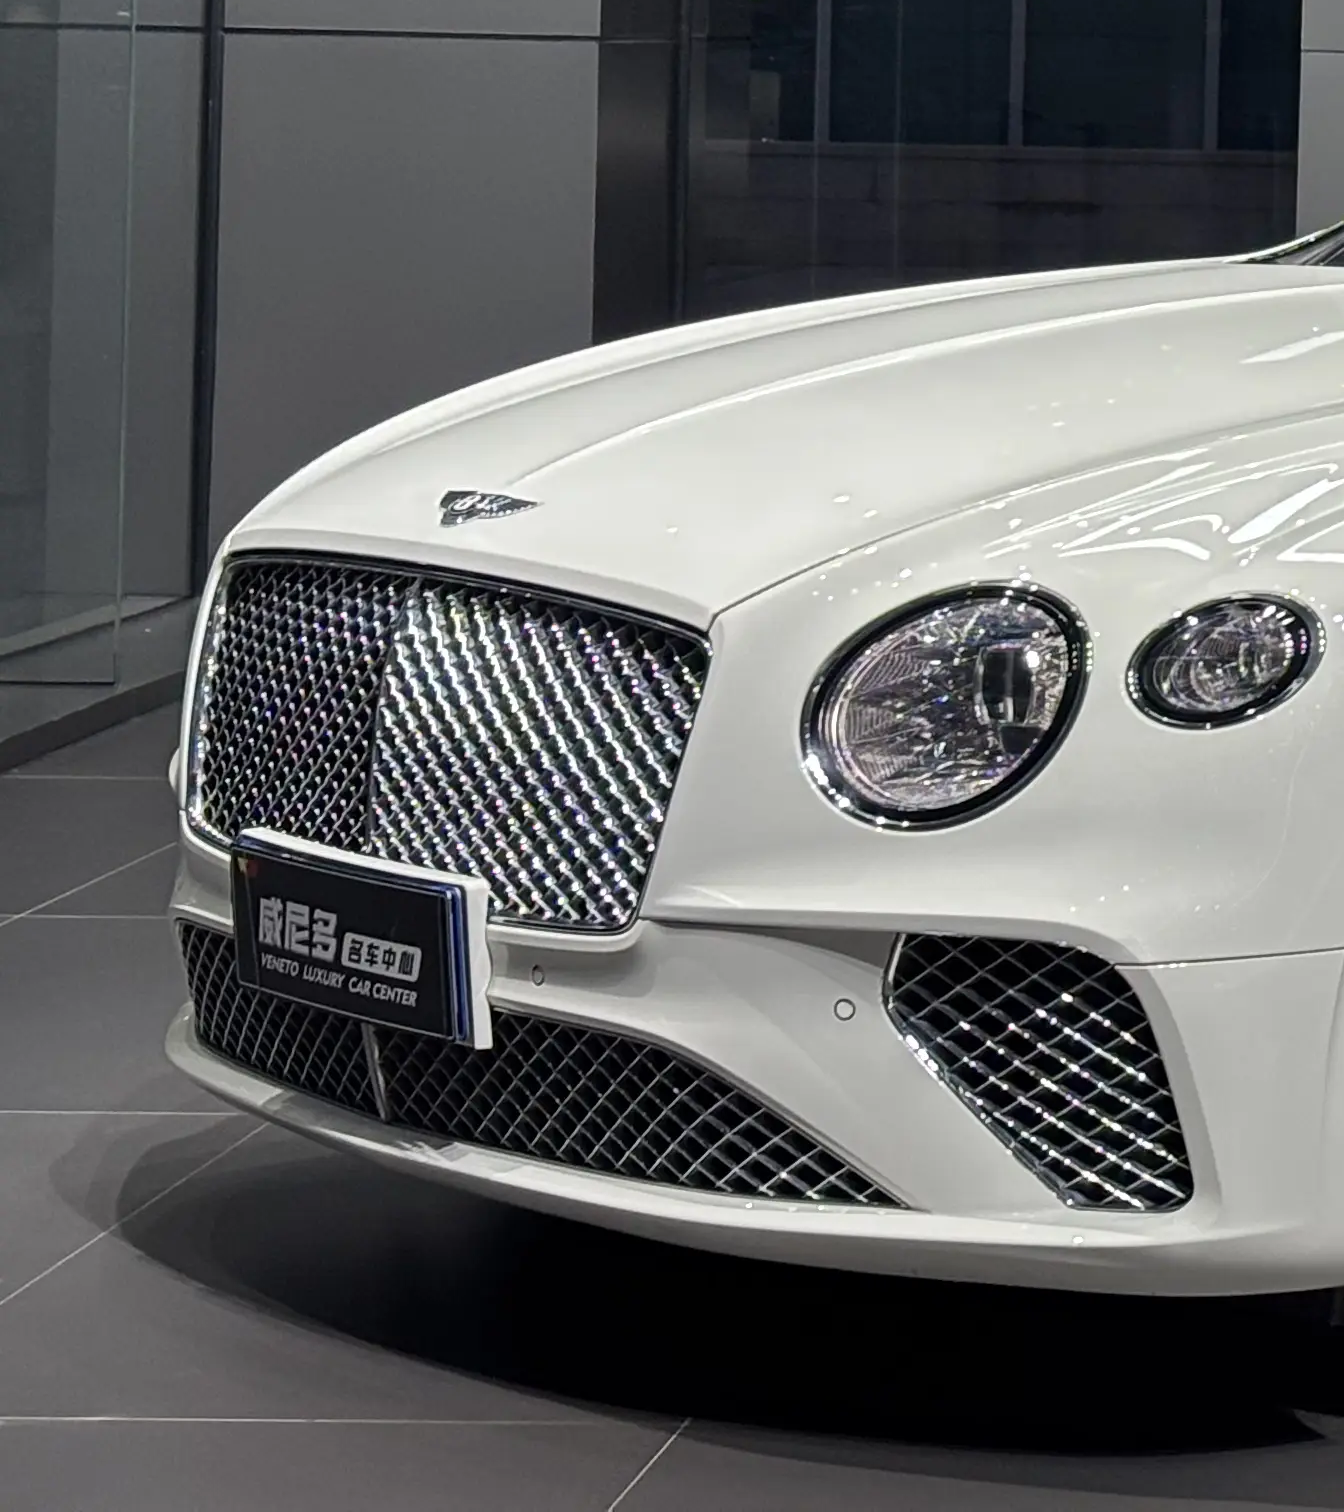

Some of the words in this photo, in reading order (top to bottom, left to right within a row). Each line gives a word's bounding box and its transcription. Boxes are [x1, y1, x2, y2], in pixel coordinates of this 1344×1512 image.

[258, 896, 338, 963] 威尼多
[347, 937, 416, 977] 名车中心
[260, 951, 300, 977] VENETO
[302, 964, 346, 989] LUXURY
[348, 976, 372, 999] CAR
[372, 982, 418, 1007] CENTER
